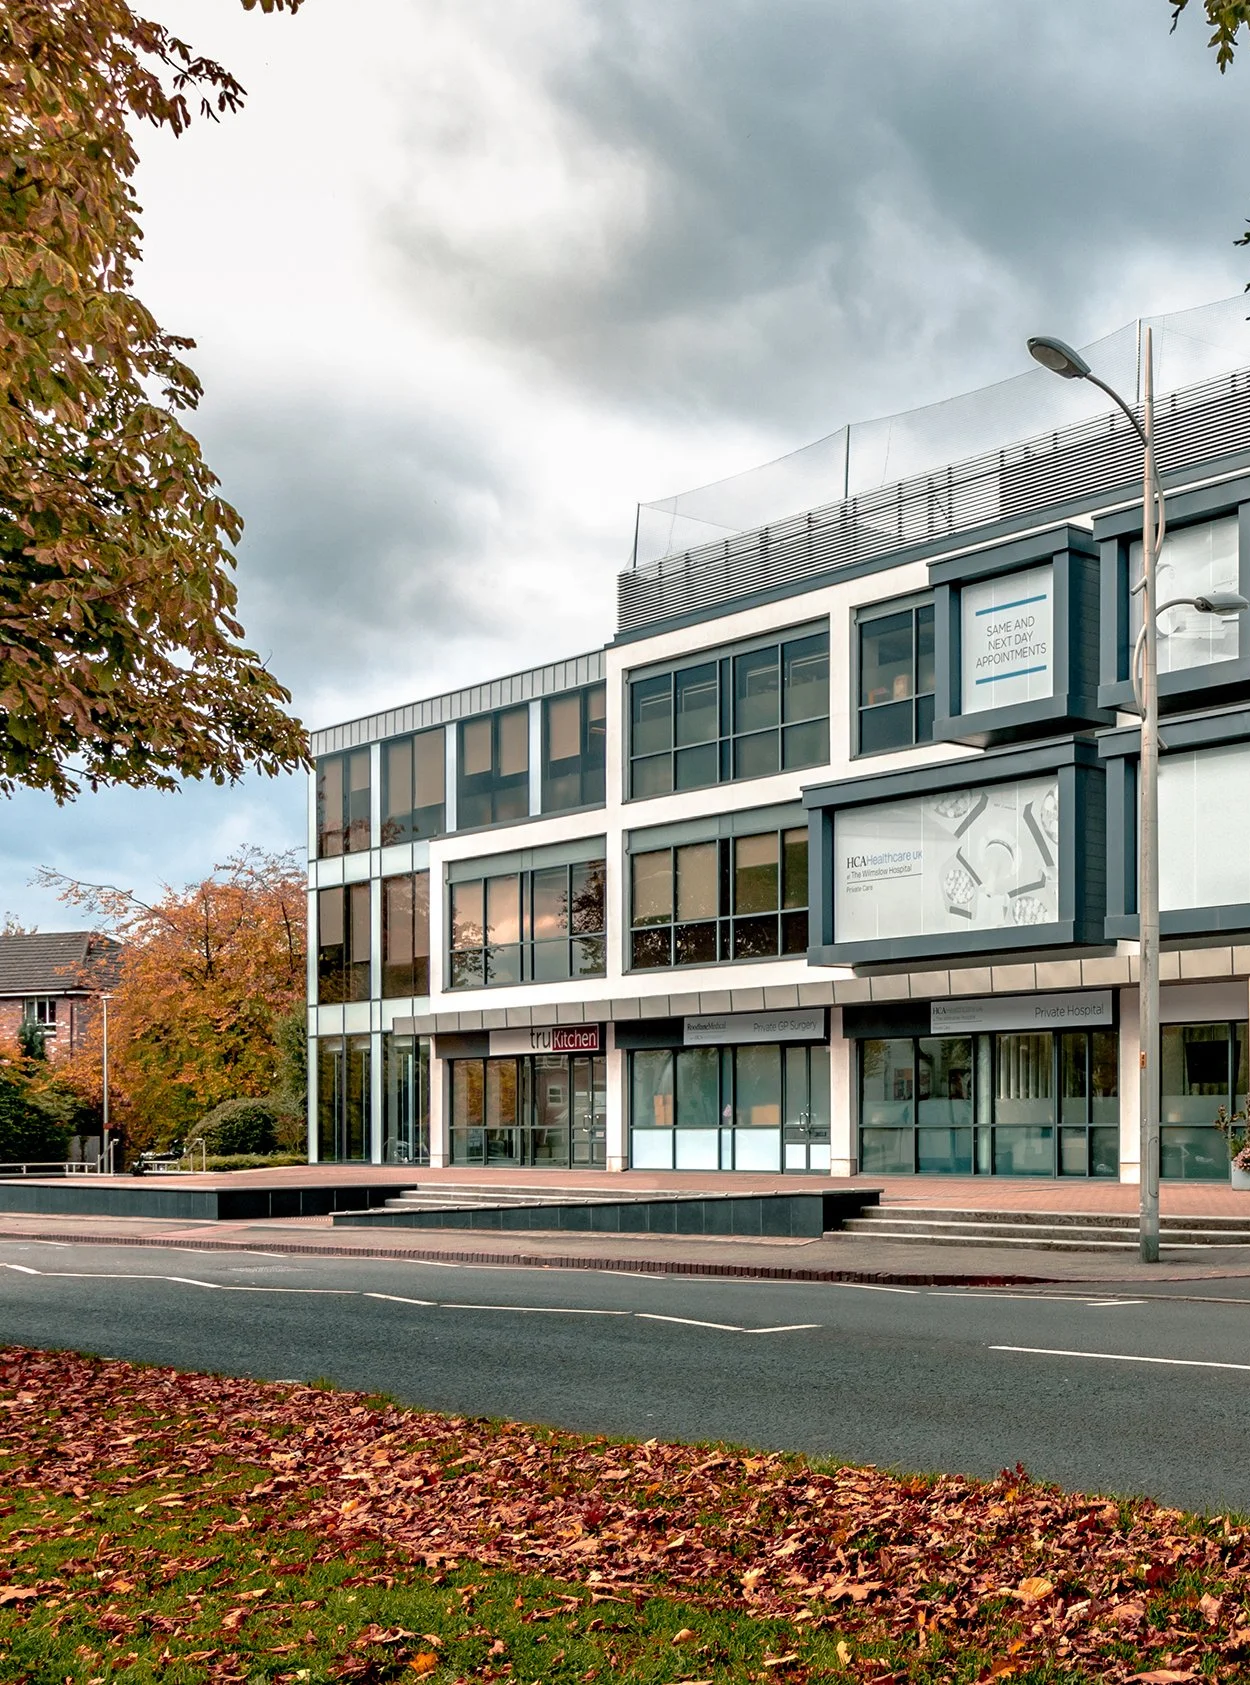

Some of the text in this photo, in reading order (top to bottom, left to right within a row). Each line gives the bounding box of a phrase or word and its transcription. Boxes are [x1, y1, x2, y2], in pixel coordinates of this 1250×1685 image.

[986, 615, 1035, 637] SAME AND
[988, 630, 1034, 651] NEXT DAY
[975, 642, 1047, 669] APPOINTMENTS
[851, 871, 862, 879] The
[861, 867, 888, 878] Wilmslow
[888, 864, 912, 874] Hospital
[846, 885, 862, 893] Private
[1034, 998, 1104, 1018] Private Hospital
[753, 1019, 817, 1032] Private GP Surgery
